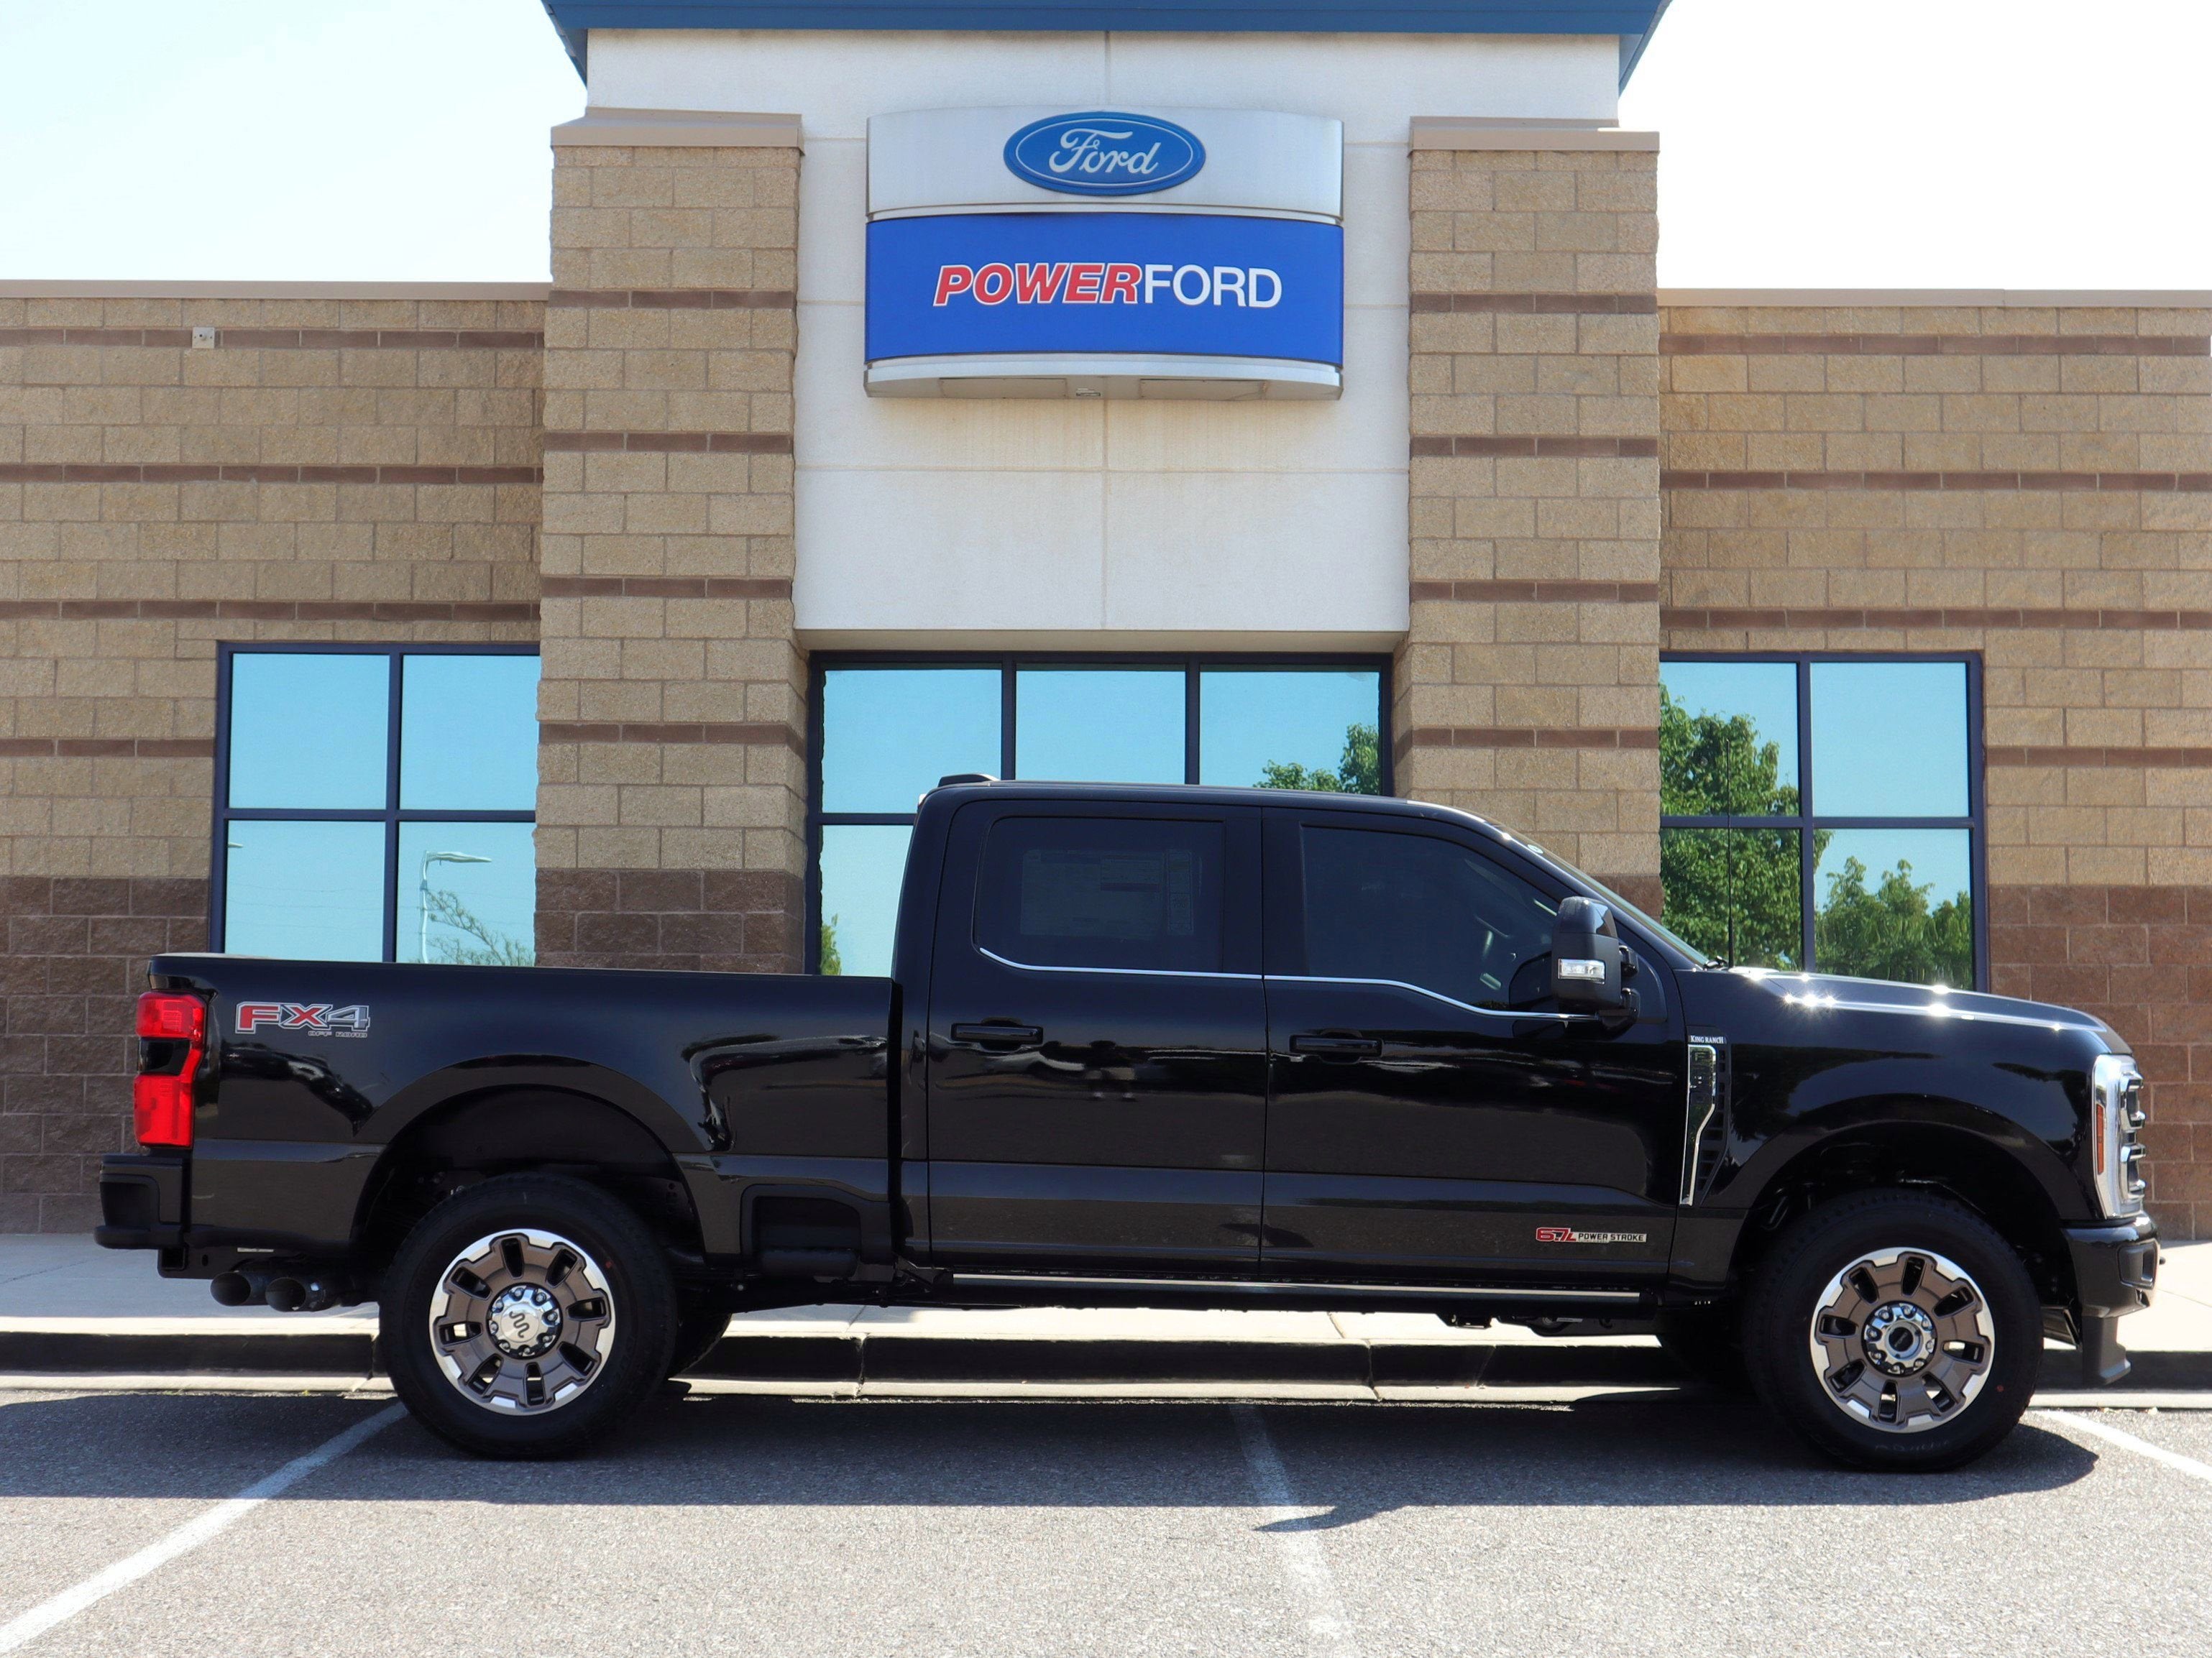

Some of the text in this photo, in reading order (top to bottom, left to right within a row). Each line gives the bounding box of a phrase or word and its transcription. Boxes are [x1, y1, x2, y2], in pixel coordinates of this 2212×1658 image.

[1049, 128, 1160, 175] Ford
[235, 1001, 370, 1033] FX4
[1690, 1035, 1704, 1044] KING
